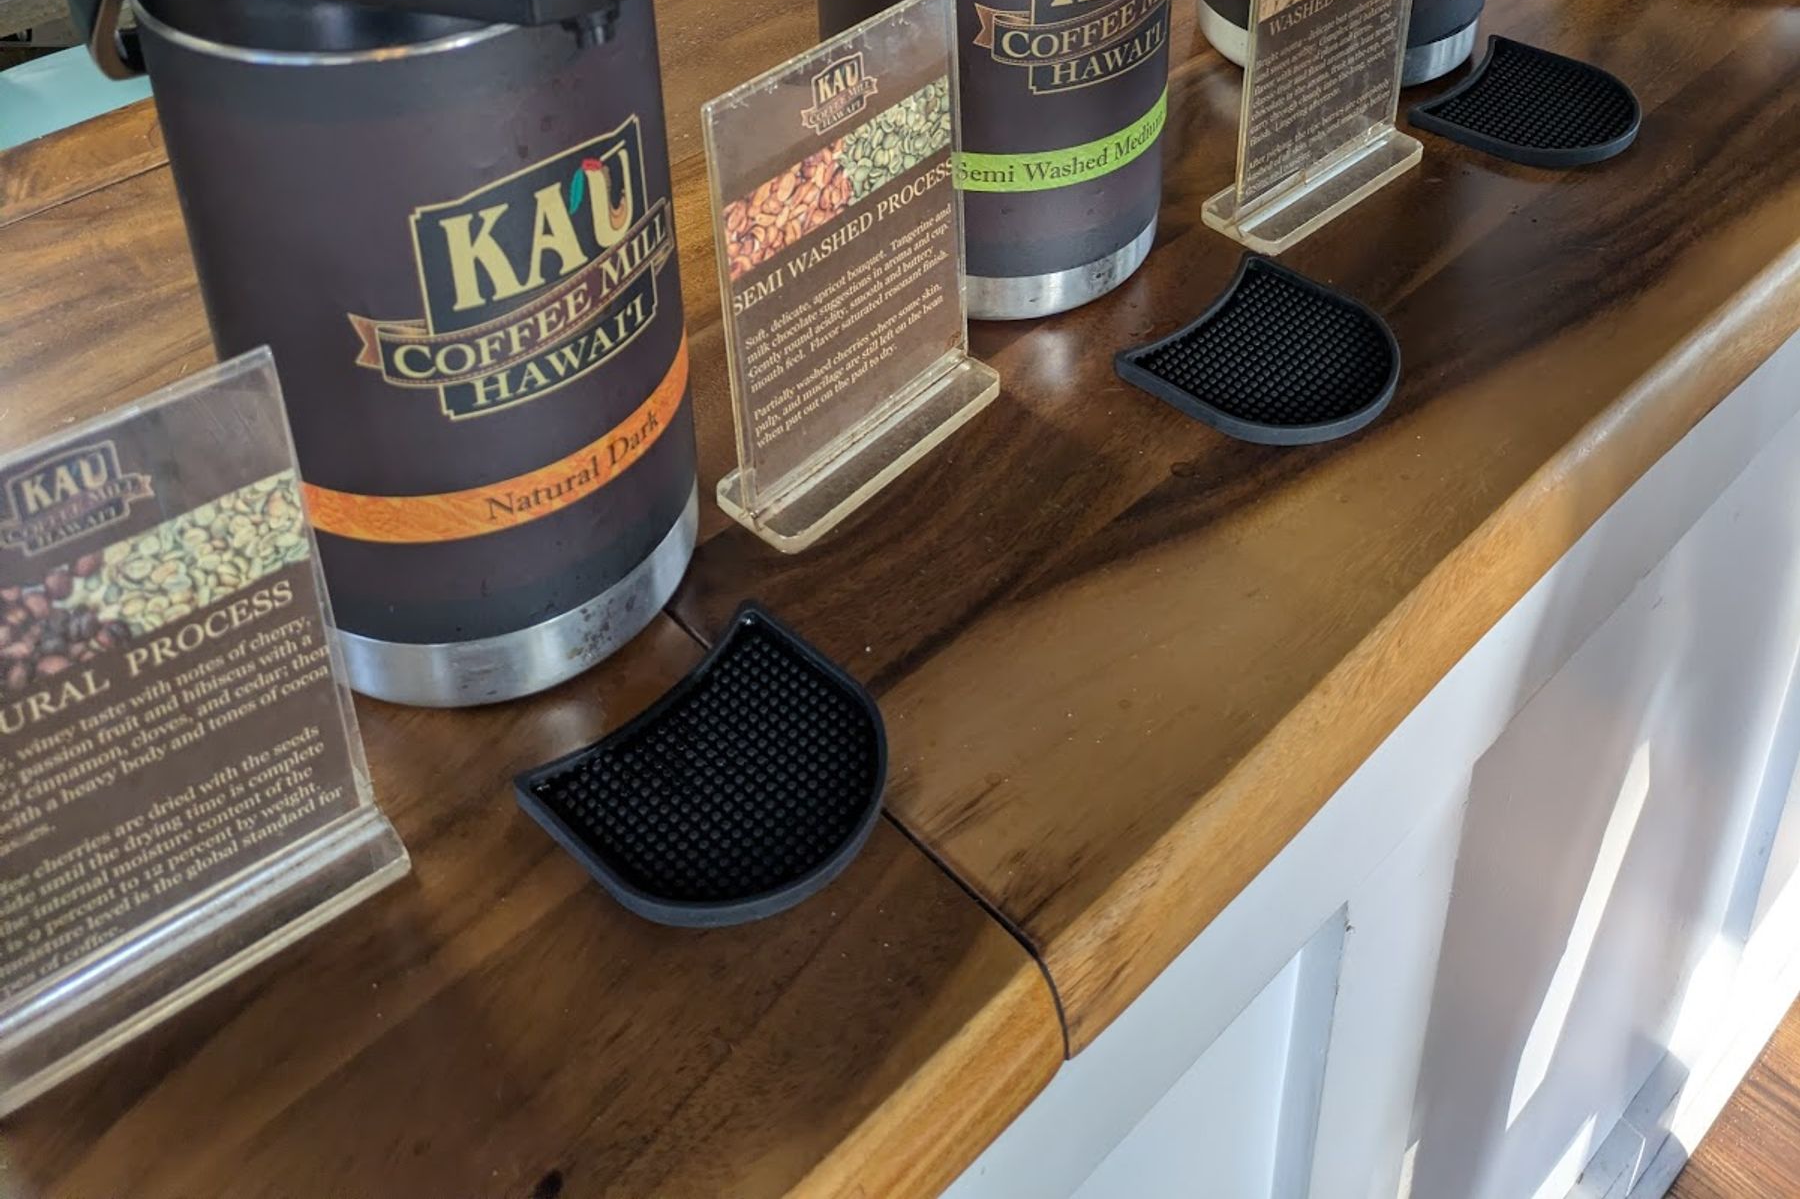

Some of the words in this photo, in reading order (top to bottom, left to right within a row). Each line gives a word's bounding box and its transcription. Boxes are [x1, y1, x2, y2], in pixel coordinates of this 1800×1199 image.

[1001, 4, 1138, 59] COFFEE
[955, 161, 1015, 184] Semi
[1022, 147, 1108, 181] Washed
[393, 281, 593, 379] COFFEE
[599, 215, 670, 299] MILL
[733, 268, 785, 317] SEMI
[788, 212, 873, 280] WASHED
[876, 156, 954, 222] PROCESS
[747, 342, 770, 363] milk
[771, 312, 817, 346] chocolate
[819, 274, 871, 314] suggestions
[872, 266, 882, 278] in
[884, 247, 912, 270] aroma
[913, 232, 930, 250] and
[813, 276, 845, 304] apricot
[890, 218, 933, 250] Tangerine
[934, 203, 951, 222] and
[469, 293, 647, 406] HAWAI'I
[748, 351, 780, 377] Gently
[783, 327, 813, 354] round
[849, 280, 883, 309] smooth
[884, 265, 901, 285] and
[902, 246, 932, 272] buttery
[751, 365, 783, 392] mouth
[810, 326, 839, 351] Flavor
[841, 293, 882, 329] saturated
[884, 268, 921, 299] resonant
[754, 387, 794, 420] Partially
[796, 358, 831, 389] washed
[833, 334, 869, 364] cherries
[870, 314, 897, 337] where
[898, 297, 920, 318] some
[782, 395, 801, 415] and
[802, 367, 843, 400] mucilage
[845, 355, 860, 370] are
[861, 339, 878, 359] still
[879, 329, 893, 345] left
[894, 321, 906, 333] on
[907, 310, 921, 324] the
[922, 295, 943, 313] bean
[484, 455, 600, 521] Natural
[607, 409, 660, 468] Dark
[756, 425, 783, 447] when
[785, 410, 801, 430] put
[803, 398, 819, 414] out
[820, 389, 833, 402] on
[834, 377, 849, 392] the
[850, 361, 868, 383] pad
[869, 356, 879, 367] to
[0, 668, 111, 735] URAL
[125, 579, 294, 677] PROCESS
[19, 739, 92, 783] passion
[97, 716, 138, 743] fruit
[144, 694, 178, 721] and
[182, 662, 255, 702] hibiscus
[259, 640, 297, 664] with
[301, 634, 311, 646] a
[26, 747, 127, 798] cinnamon,
[131, 715, 192, 748] cloves,
[197, 689, 230, 716] and
[234, 666, 287, 697] cedar;
[291, 641, 330, 669] then
[79, 703, 125, 730] taste
[129, 680, 171, 706] with
[176, 656, 224, 685] notes
[227, 640, 245, 660] of
[249, 617, 310, 650] cherry,
[34, 833, 110, 877] cherries
[115, 815, 143, 837] are
[148, 786, 195, 819] dried
[199, 767, 237, 792] with
[241, 751, 269, 771] the
[273, 727, 318, 755] seeds
[45, 798, 58, 811] a
[60, 768, 115, 802] heavy
[119, 745, 165, 773] body
[171, 722, 204, 749] and
[208, 701, 255, 729] tones
[259, 685, 277, 705] of
[281, 665, 328, 694] cocoa
[33, 870, 108, 917] internal
[113, 830, 191, 876] moisture
[197, 793, 260, 832] content
[264, 777, 281, 797] of
[285, 767, 311, 786] the
[40, 862, 84, 894] until
[88, 848, 118, 869] the
[124, 816, 182, 851] drying
[185, 793, 225, 819] time
[229, 783, 244, 797] is
[248, 742, 323, 786] complete
[45, 888, 114, 934] percent
[119, 877, 139, 893] to
[144, 863, 163, 879] 12
[168, 827, 232, 870] percent
[235, 814, 256, 831] by
[261, 783, 319, 816] weight.
[86, 897, 130, 929] level
[133, 891, 150, 905] is
[153, 873, 182, 893] the
[186, 840, 237, 879] global
[243, 799, 314, 845] standard
[318, 786, 341, 805] for
